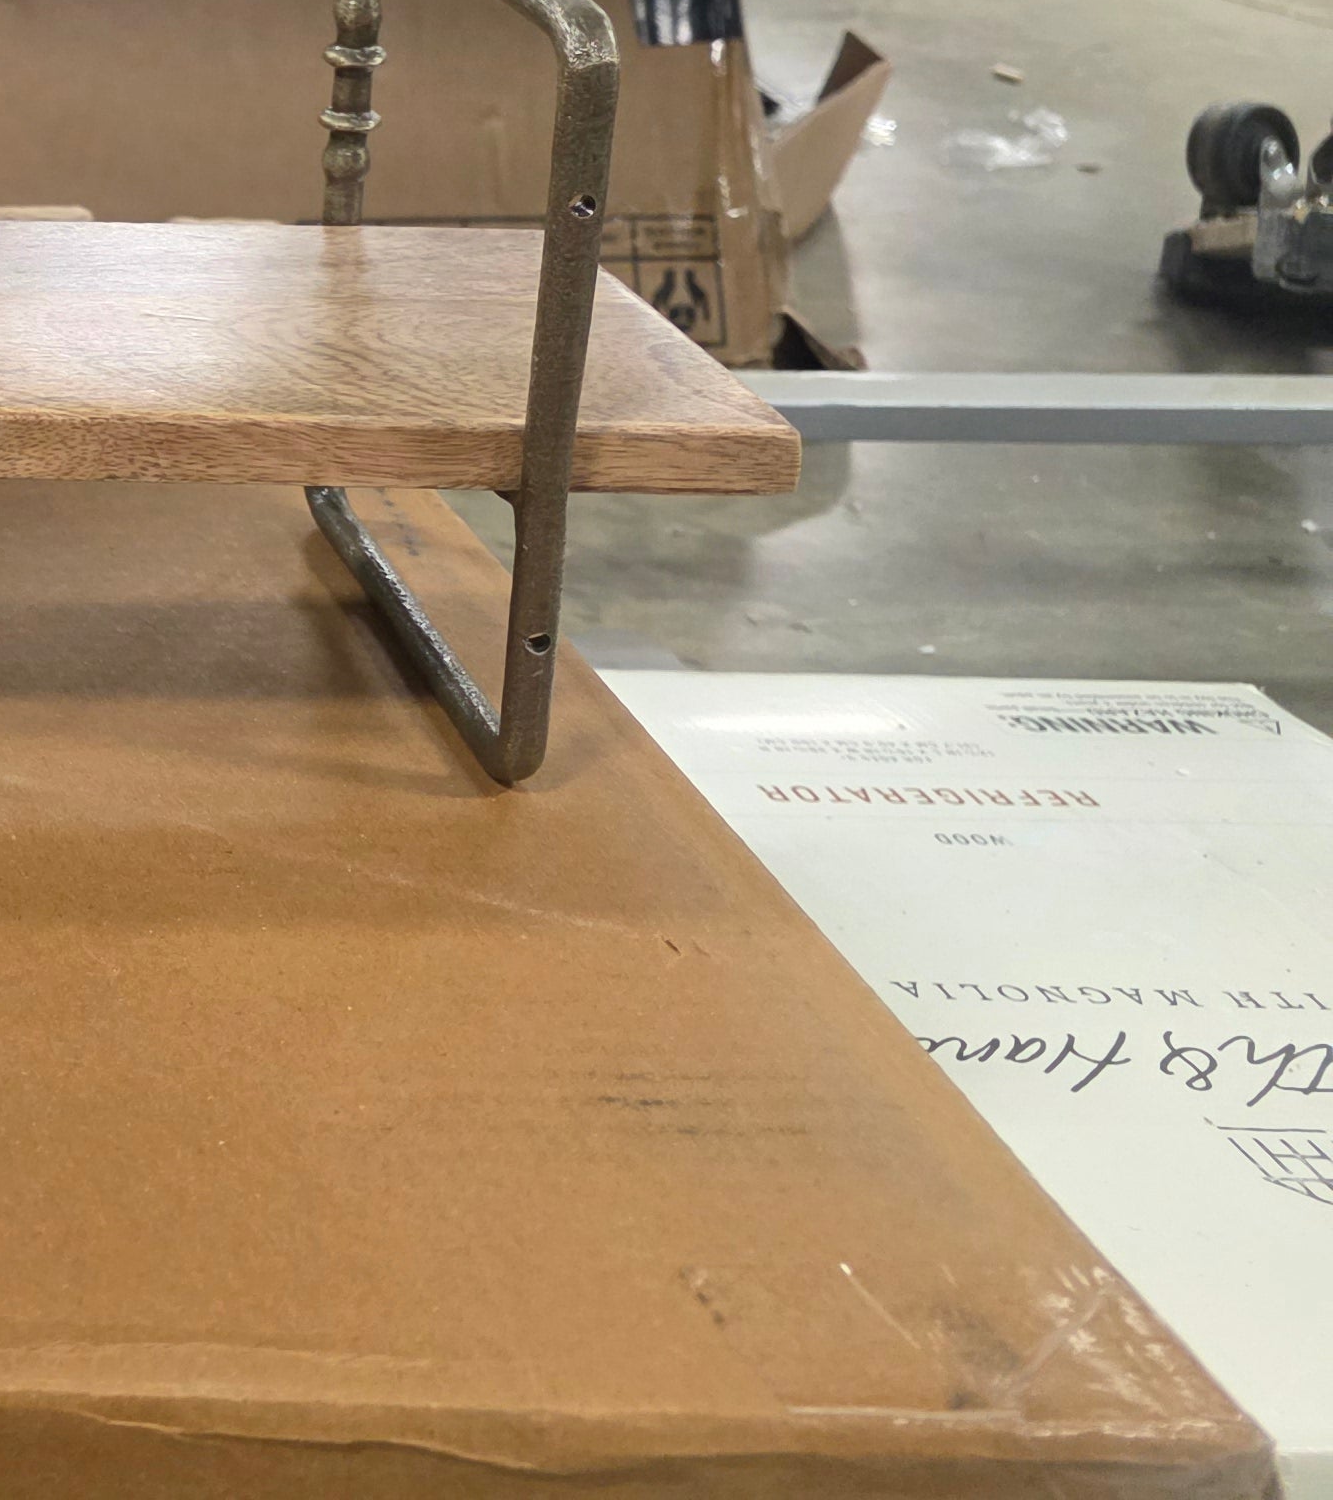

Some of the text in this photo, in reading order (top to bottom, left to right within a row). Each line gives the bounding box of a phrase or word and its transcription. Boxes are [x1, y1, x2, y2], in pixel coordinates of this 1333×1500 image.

[998, 714, 1218, 736] WARNING:
[757, 784, 1101, 808] REFRIGERATOR
[934, 832, 1014, 847] WOOD
[890, 980, 1332, 1011] ITH MAGNOLIA
[1159, 1031, 1218, 1091] &
